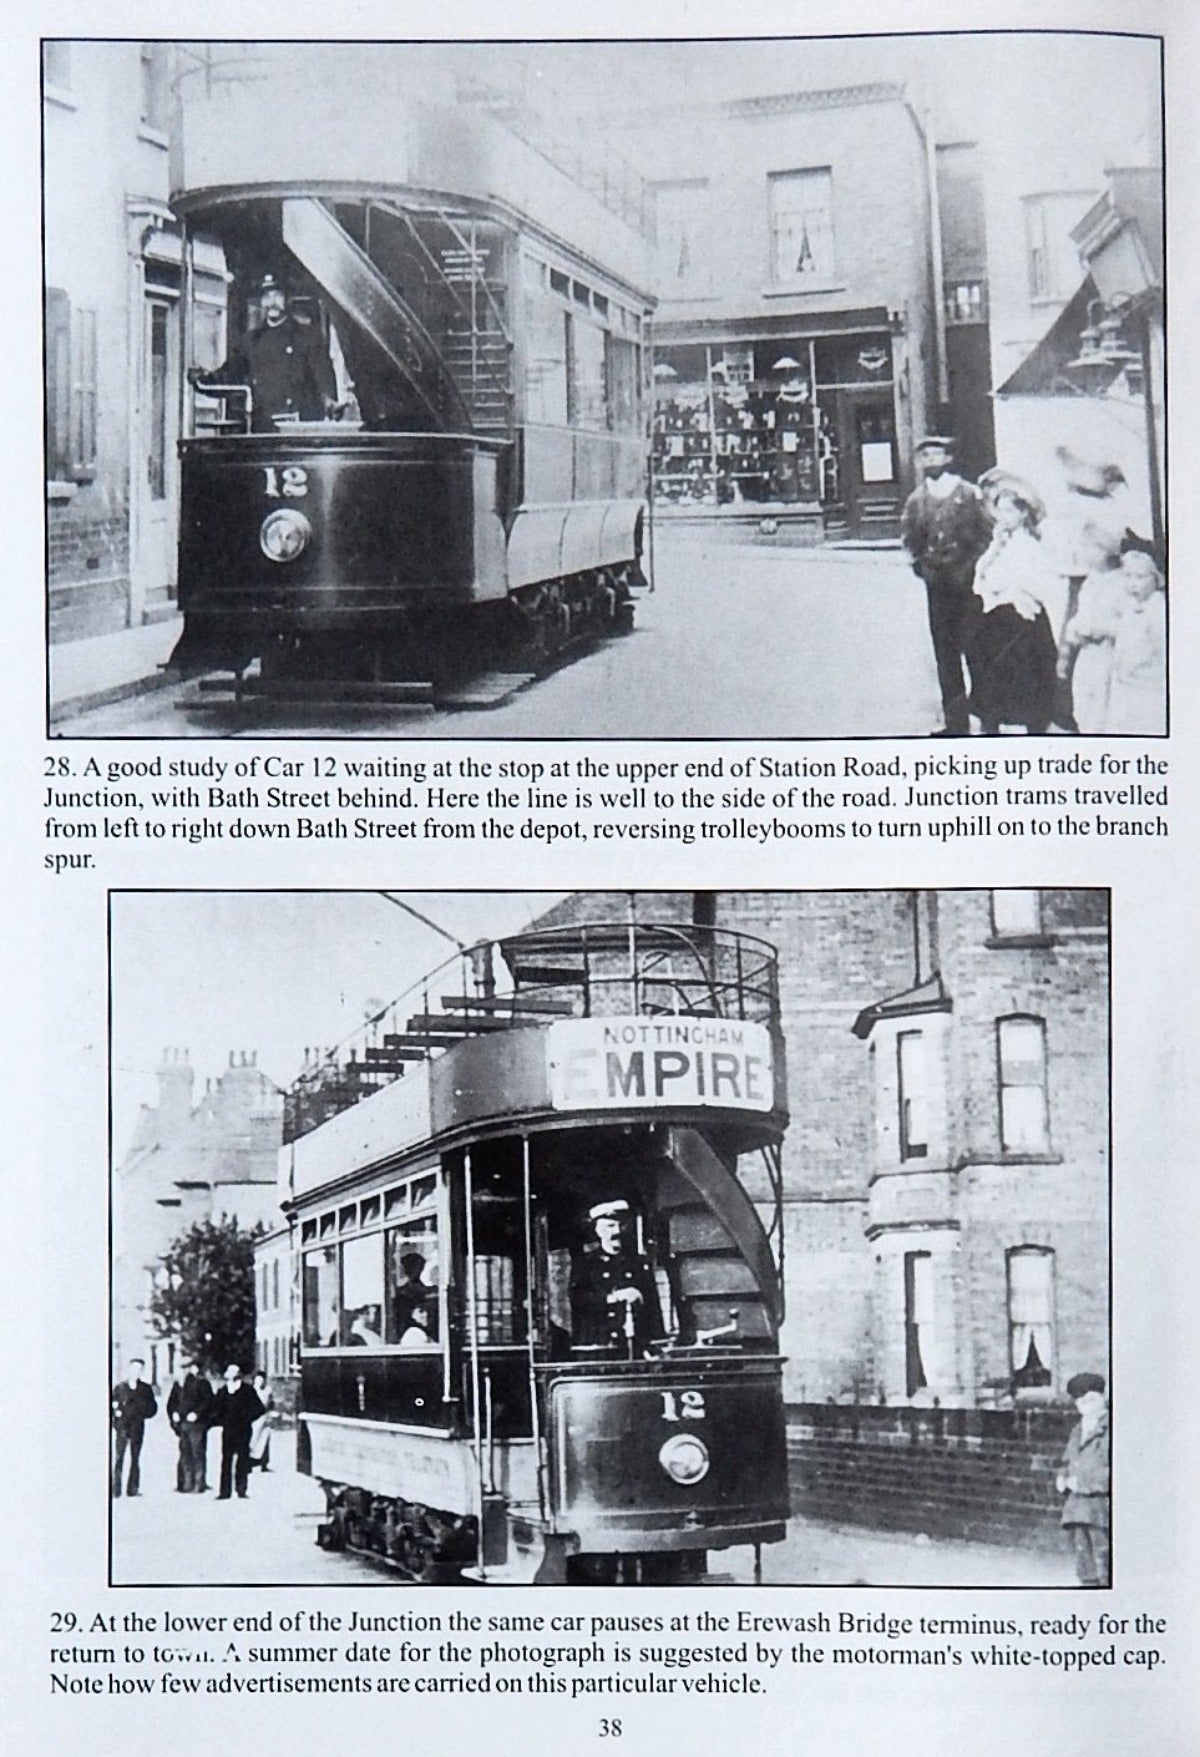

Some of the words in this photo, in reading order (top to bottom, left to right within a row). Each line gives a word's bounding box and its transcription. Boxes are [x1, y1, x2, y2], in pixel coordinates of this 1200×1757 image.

[264, 466, 308, 497] 12
[43, 755, 77, 777] 28.
[82, 756, 103, 778] A
[106, 755, 163, 783] good
[168, 755, 229, 783] study
[233, 755, 262, 778] of
[264, 757, 307, 778] Car
[312, 756, 337, 778] 12
[343, 756, 428, 784] waiting
[432, 760, 453, 778] at
[458, 756, 493, 778] the
[498, 760, 545, 784] stop
[550, 760, 571, 778] at
[575, 756, 610, 778] the
[615, 762, 680, 784] upper
[684, 756, 724, 779] end
[729, 756, 757, 778] of
[759, 756, 836, 778] Station
[842, 755, 908, 779] Road,
[914, 754, 998, 782] picking
[1003, 759, 1032, 780] up
[1037, 752, 1093, 775] trade
[1099, 753, 1132, 775] for
[1135, 753, 1169, 776] the
[43, 786, 145, 812] Junction,
[150, 785, 201, 808] with
[208, 786, 260, 809] Bath
[266, 786, 331, 809] Street
[336, 786, 419, 809] behind.
[426, 787, 480, 809] Here
[486, 787, 520, 809] the
[527, 786, 568, 809] line
[575, 786, 593, 809] is
[599, 787, 646, 809] well
[653, 790, 675, 809] to
[680, 787, 715, 809] the
[721, 786, 766, 809] side
[771, 786, 799, 809] of
[801, 786, 836, 809] the
[841, 785, 897, 808] road.
[904, 784, 999, 807] Junction
[1005, 787, 1068, 805] trams
[1074, 784, 1169, 806] travelled
[44, 816, 98, 839] from
[103, 816, 140, 839] left
[144, 820, 167, 839] to
[171, 816, 224, 845] right
[228, 817, 291, 839] down
[296, 817, 348, 839] Bath
[354, 817, 418, 840] Street
[422, 816, 476, 839] from
[481, 817, 515, 840] the
[519, 817, 588, 845] depot,
[593, 817, 696, 845] reversing
[700, 817, 846, 845] trolleybooms
[851, 820, 873, 838] to
[877, 819, 922, 838] turn
[927, 815, 992, 843] uphill
[997, 820, 1025, 836] on
[1030, 817, 1052, 836] to
[1057, 814, 1091, 836] the
[1095, 814, 1169, 837] branch
[44, 853, 96, 875] spur.
[603, 1026, 744, 1048] NOTTINGHAM
[564, 1050, 764, 1100] EMPIRE
[660, 1391, 706, 1422] 12
[49, 1611, 84, 1634] 29.
[88, 1612, 117, 1633] At
[122, 1611, 158, 1633] the
[164, 1610, 229, 1633] lower
[232, 1610, 273, 1632] end
[278, 1610, 306, 1632] of
[308, 1610, 343, 1632] the
[347, 1610, 442, 1632] Junction
[448, 1610, 482, 1632] the
[487, 1616, 545, 1632] same
[550, 1616, 586, 1632] car
[590, 1616, 665, 1638] pauses
[669, 1614, 690, 1632] at
[695, 1610, 730, 1632] the
[736, 1610, 831, 1633] Erewash
[838, 1611, 914, 1640] Bridge
[919, 1613, 1024, 1638] terminus,
[1029, 1613, 1092, 1641] ready
[1097, 1612, 1130, 1635] for
[1134, 1612, 1167, 1635] the
[50, 1646, 116, 1664] return
[123, 1645, 146, 1664] to
[248, 1646, 339, 1663] summer
[344, 1640, 391, 1663] date
[399, 1640, 432, 1663] for
[438, 1640, 473, 1663] the
[479, 1640, 606, 1669] photograph
[613, 1640, 632, 1663] is
[639, 1641, 748, 1669] suggested
[755, 1641, 784, 1669] by
[790, 1641, 825, 1664] the
[832, 1644, 963, 1666] motorman's
[970, 1644, 1117, 1672] white-topped
[1123, 1649, 1166, 1671] cap.
[49, 1673, 104, 1695] Note
[107, 1672, 156, 1695] how
[160, 1671, 202, 1694] few
[205, 1671, 373, 1694] advertisements
[376, 1677, 411, 1694] are
[414, 1671, 492, 1694] carried
[495, 1677, 523, 1694] on
[527, 1671, 567, 1694] this
[571, 1671, 678, 1699] particular
[681, 1671, 767, 1694] vehicle.
[598, 1718, 623, 1738] 38
